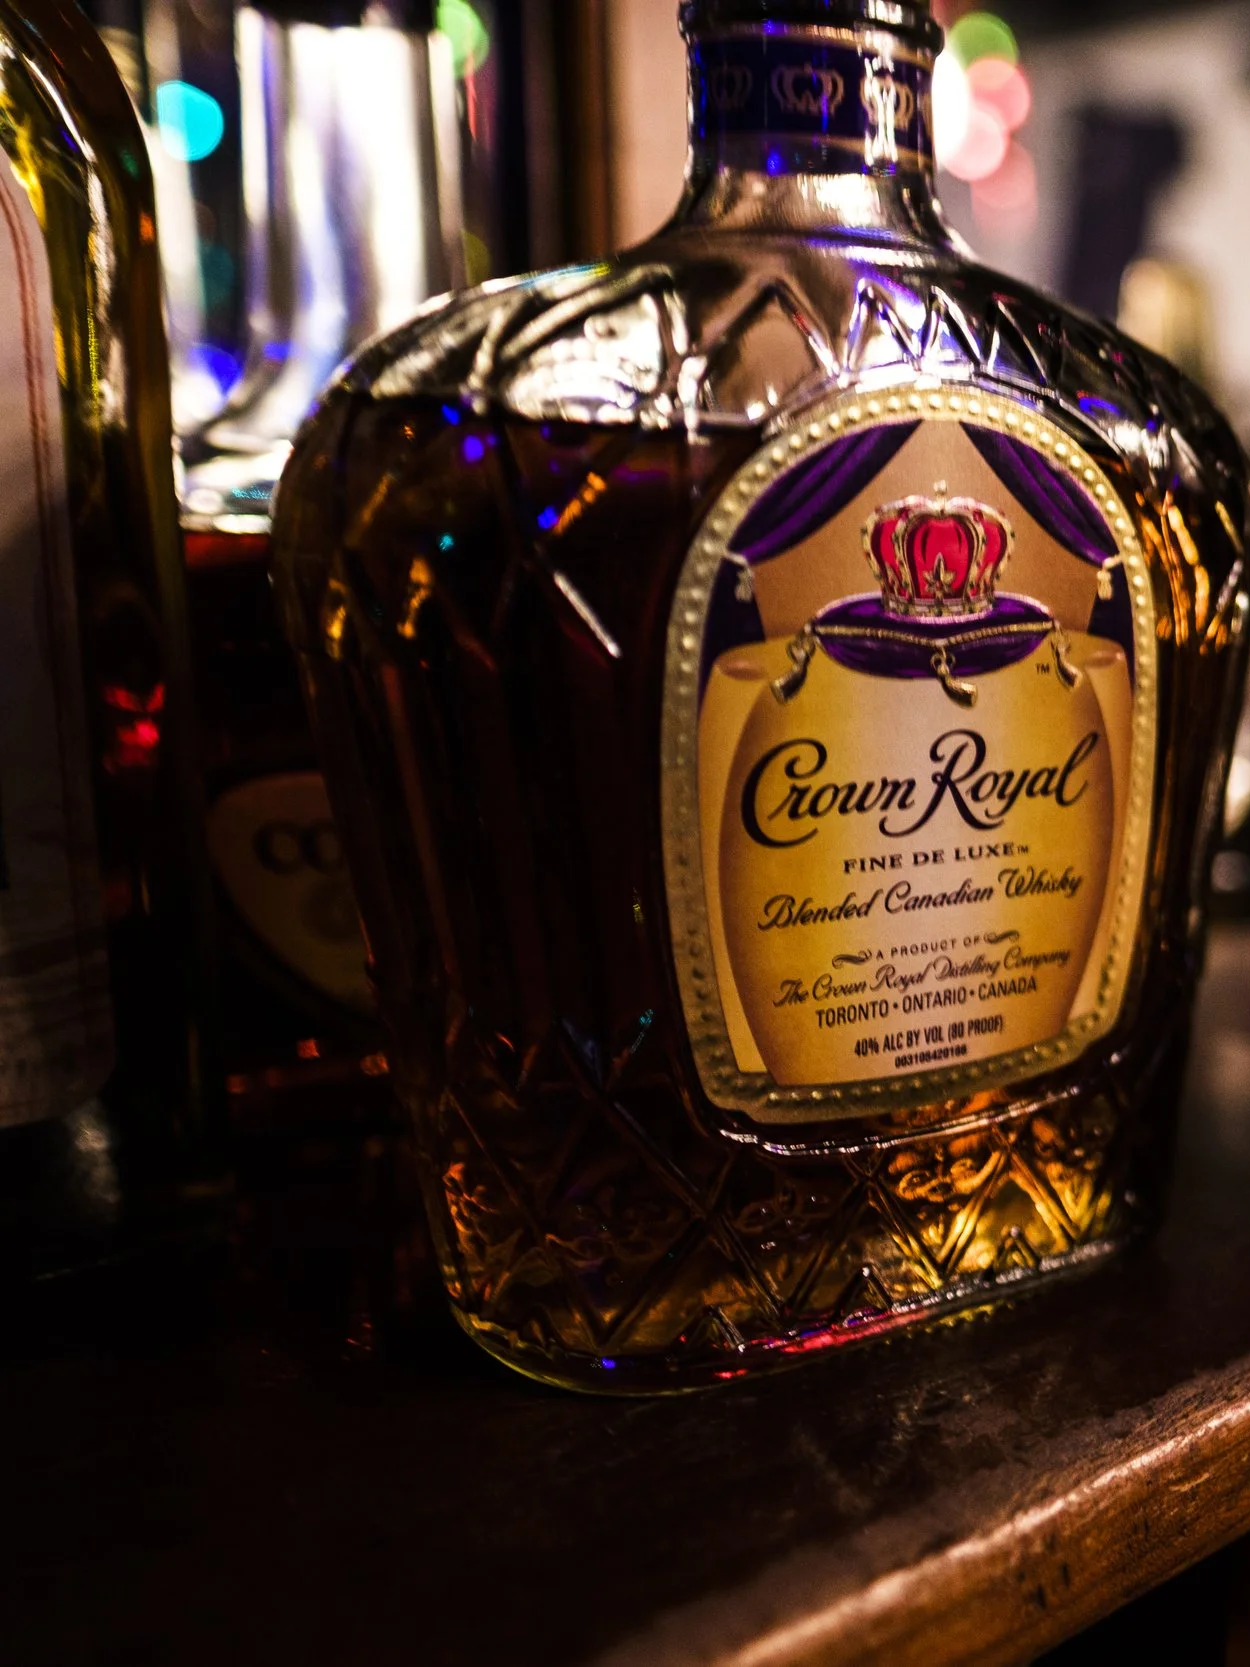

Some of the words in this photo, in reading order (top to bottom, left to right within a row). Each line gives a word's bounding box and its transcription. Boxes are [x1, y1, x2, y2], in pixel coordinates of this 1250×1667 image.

[741, 738, 917, 848] Crown
[879, 729, 1098, 837] Royal
[843, 854, 902, 874] FINE
[913, 850, 945, 867] DE
[757, 888, 883, 931] Blended
[885, 878, 994, 913] Canadian
[998, 866, 1083, 898] Whisky
[876, 949, 884, 960] A
[891, 938, 956, 957] PRODUCT
[963, 935, 981, 947] OF
[773, 978, 809, 1008] The
[812, 973, 867, 1001] Crown
[870, 962, 933, 993] Royal
[933, 953, 1001, 981] Distilling
[1004, 945, 1070, 970] Company
[815, 999, 889, 1029] TORONTO
[902, 986, 967, 1014] ONTARIO
[978, 976, 1037, 1001] CANADA
[854, 1037, 879, 1057] 40%
[883, 1032, 903, 1051] ALC
[906, 1028, 920, 1048] BY
[924, 1025, 944, 1045] VOL
[947, 1021, 964, 1042] (80
[967, 1014, 1004, 1035] PROOF)
